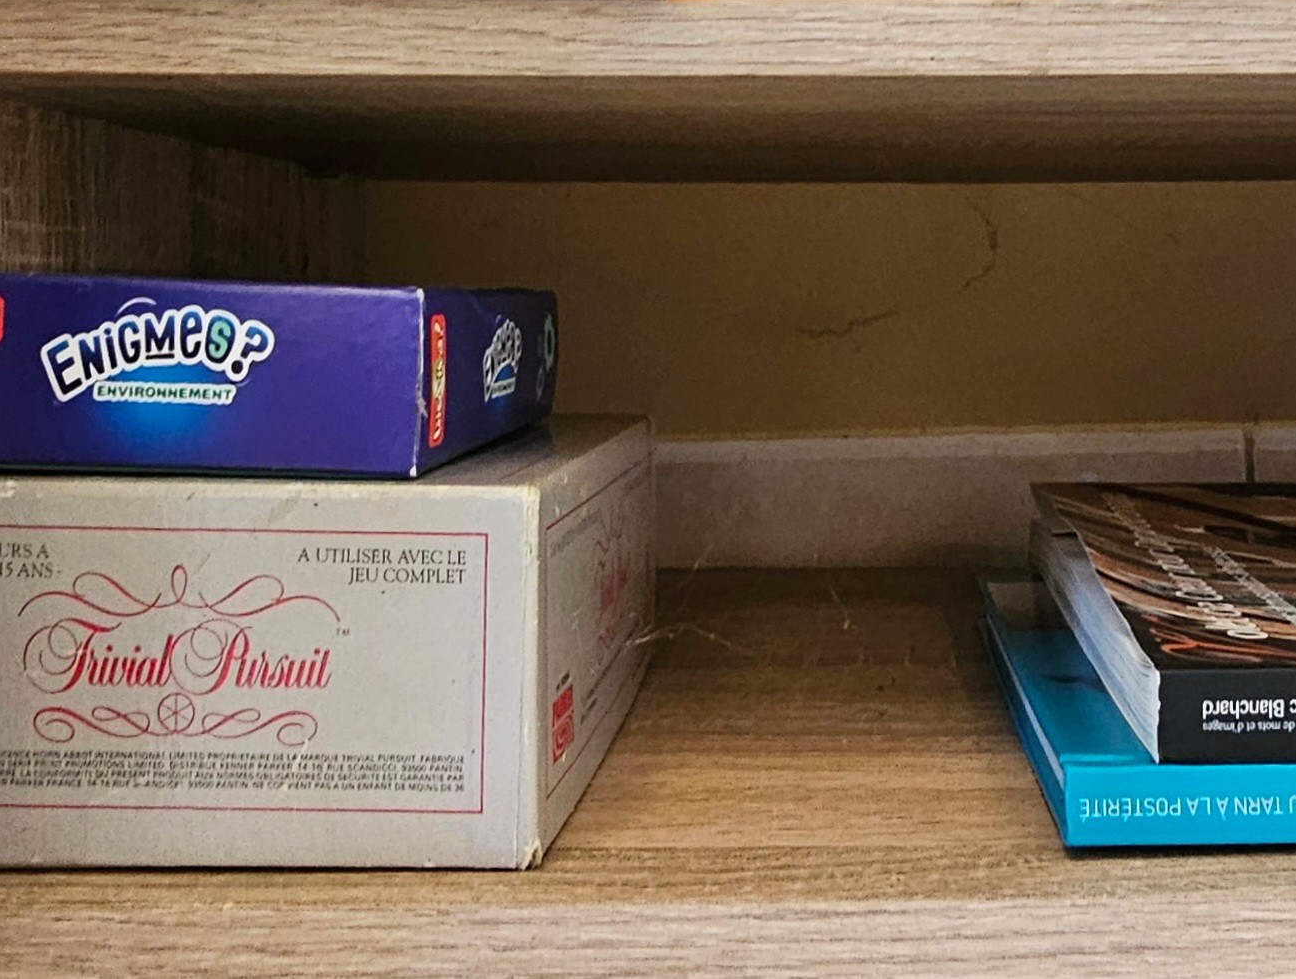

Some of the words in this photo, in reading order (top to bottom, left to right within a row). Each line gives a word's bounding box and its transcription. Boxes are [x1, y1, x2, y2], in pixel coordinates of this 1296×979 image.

[97, 384, 233, 401] ENVIRONNEMENT
[36, 543, 50, 559] A
[297, 547, 310, 563] A
[316, 547, 393, 564] UTILISER
[397, 549, 443, 565] AVEC
[447, 550, 467, 566] LE
[348, 567, 379, 586] JEU
[383, 567, 467, 584] COMPLET
[23, 618, 174, 694] Trivial
[169, 619, 333, 696] Pursuit
[1202, 698, 1285, 720] Blanchard
[1079, 797, 1182, 822] POSTÉRITÉ
[1186, 797, 1211, 816] LA
[1217, 797, 1228, 822] À
[1233, 796, 1283, 815] TARN
